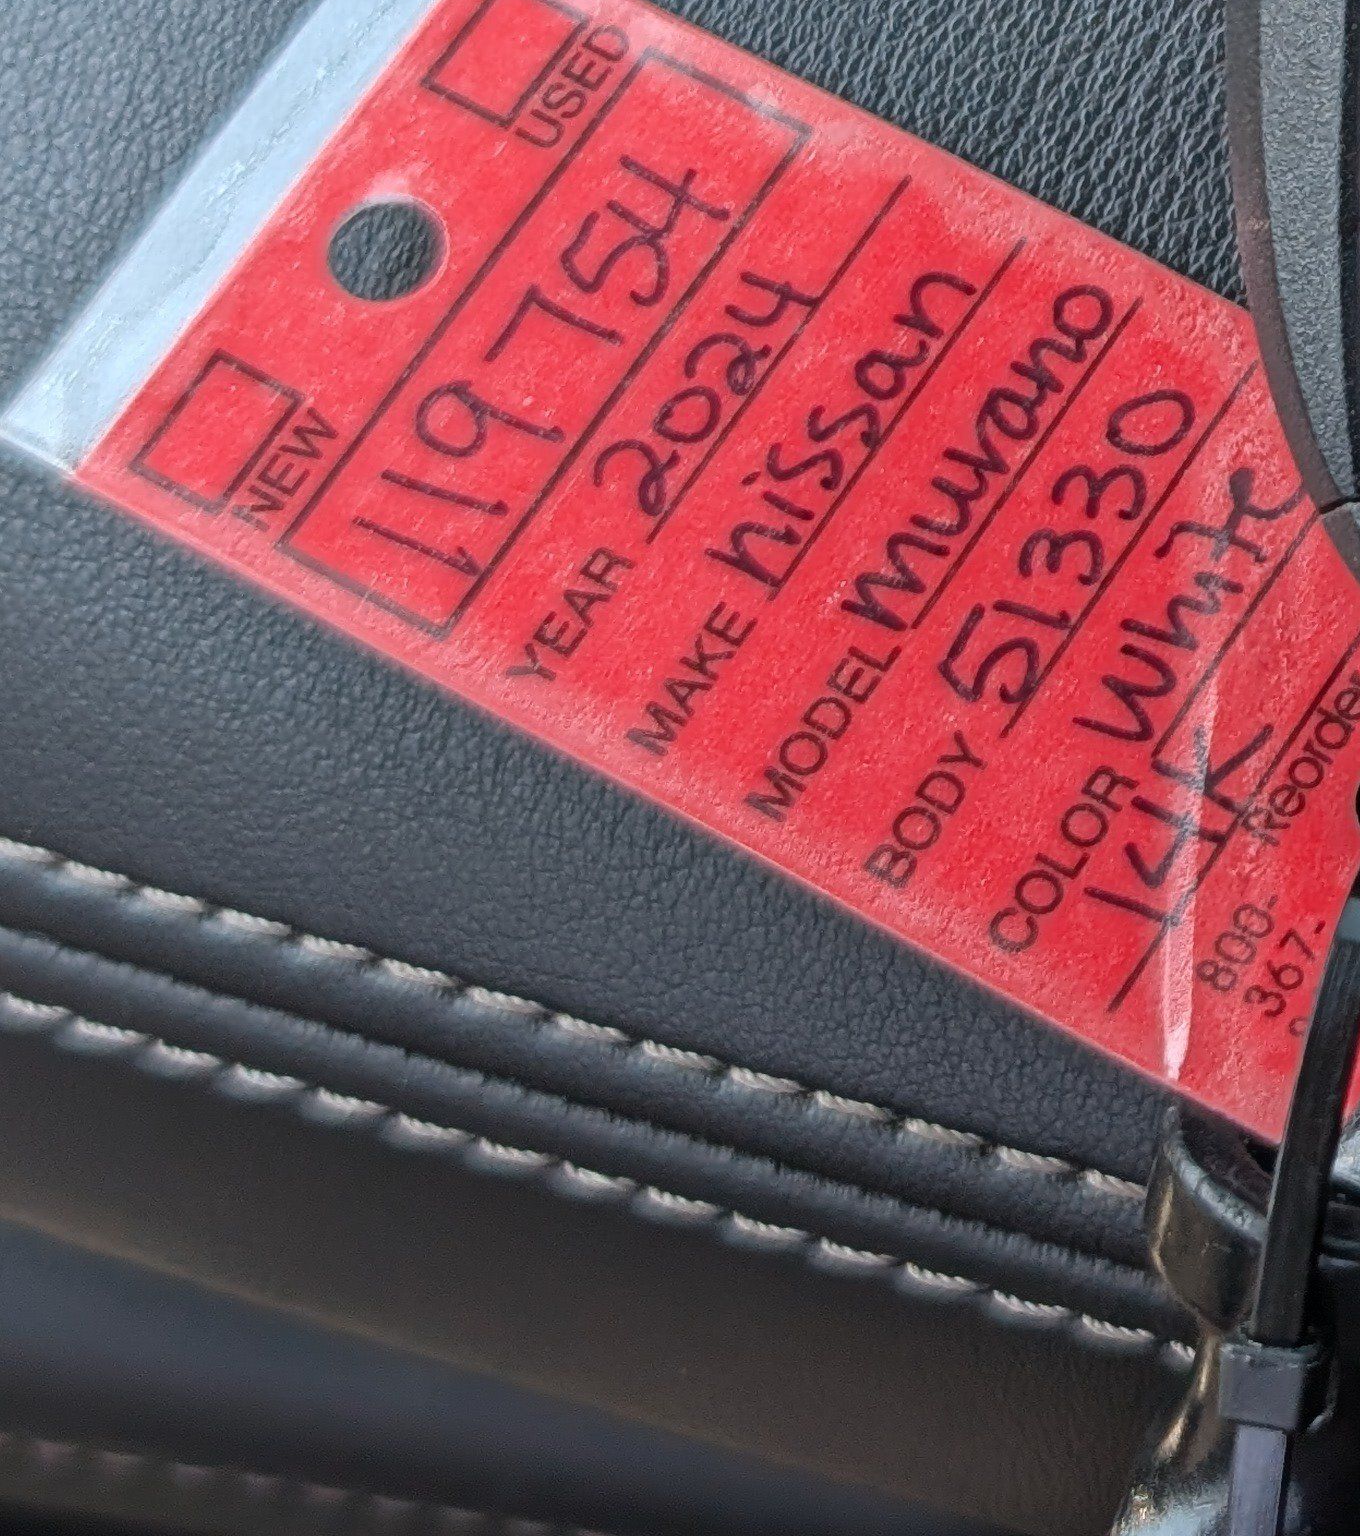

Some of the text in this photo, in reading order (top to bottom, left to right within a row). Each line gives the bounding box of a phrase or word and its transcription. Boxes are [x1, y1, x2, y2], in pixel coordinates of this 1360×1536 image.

[517, 22, 632, 150] USED
[352, 154, 732, 579] 119754
[231, 408, 341, 532] NEW
[508, 270, 822, 681] YEAR 2024
[626, 600, 756, 758] MAKE
[864, 387, 1198, 891] BODY 51330
[747, 646, 904, 824] MODEL
[987, 763, 1139, 954] COLOR
[1196, 894, 1280, 994] 800-
[1243, 920, 1327, 1019] 367-
